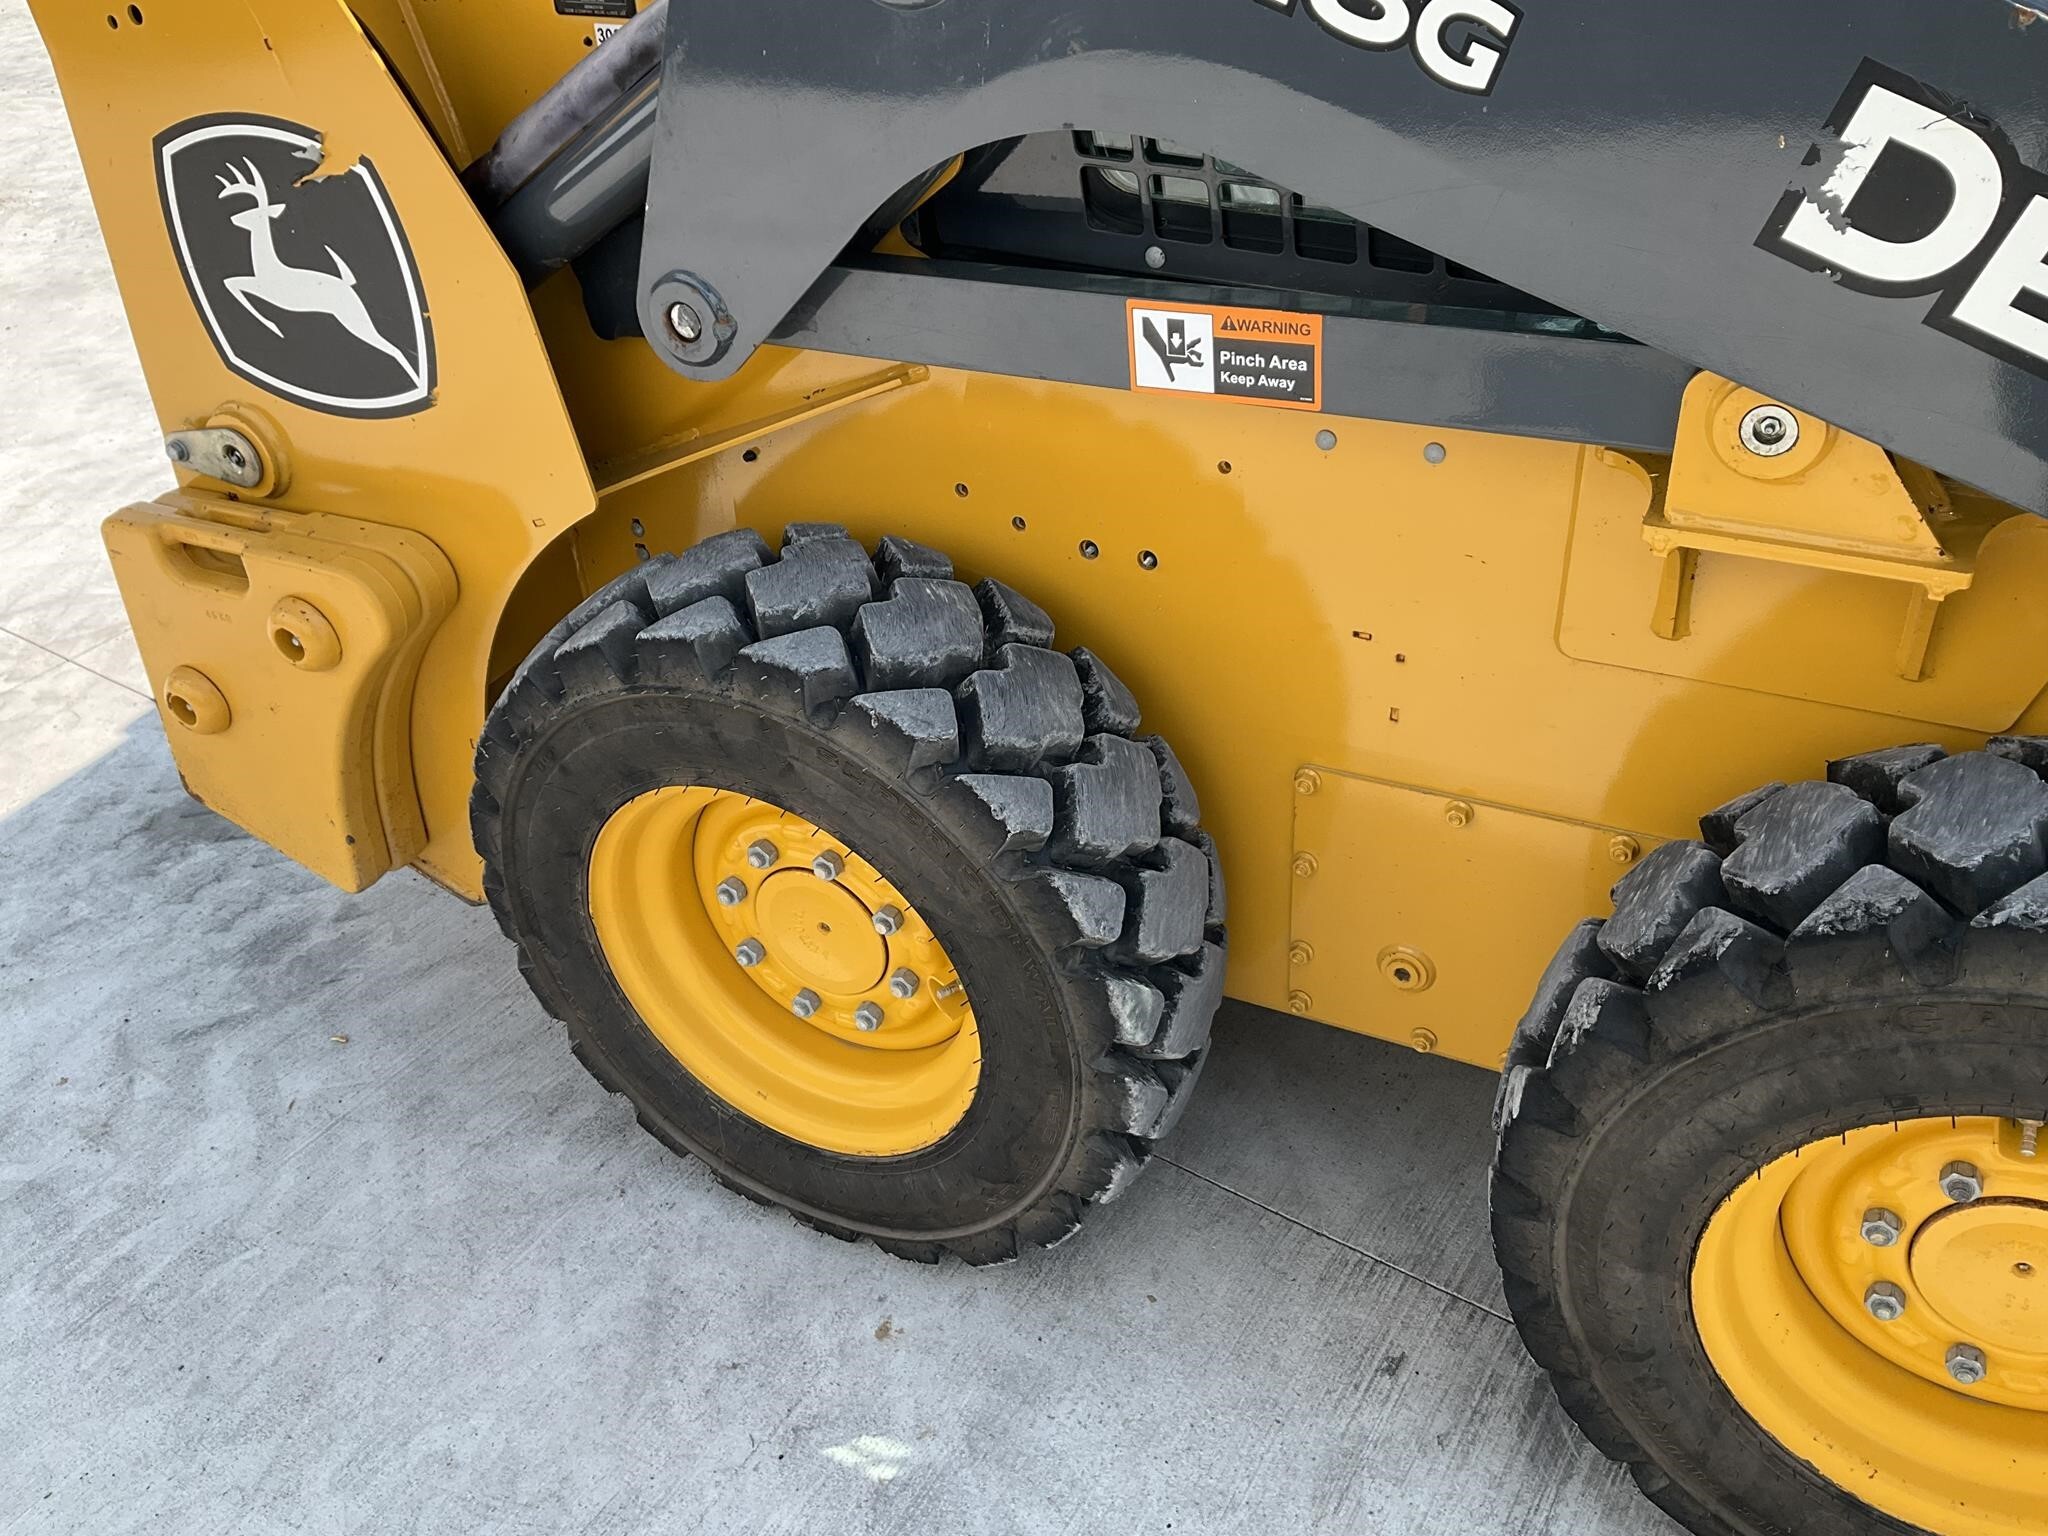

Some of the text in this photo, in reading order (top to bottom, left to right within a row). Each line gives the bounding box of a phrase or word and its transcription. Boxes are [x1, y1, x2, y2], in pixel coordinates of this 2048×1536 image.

[597, 27, 620, 42] 30
[1237, 319, 1311, 336] WARNING
[1220, 351, 1307, 371] Pinch Area
[1220, 371, 1295, 391] Keep Away
